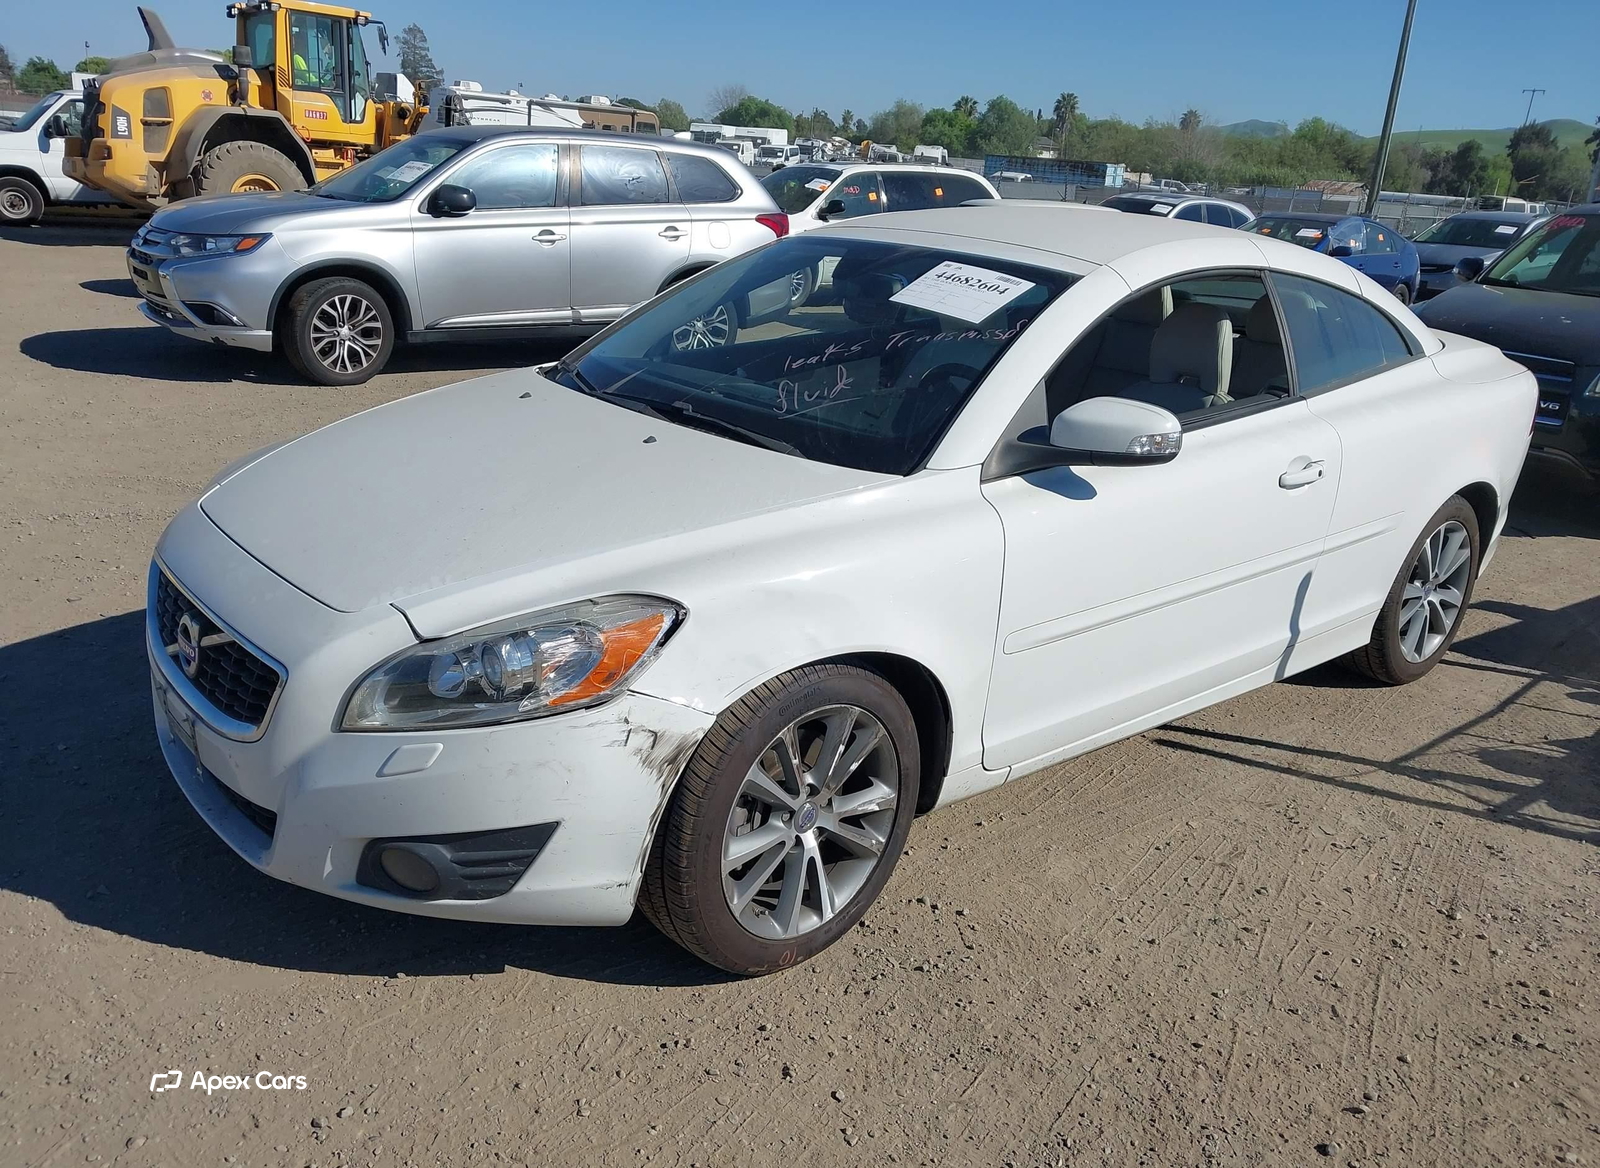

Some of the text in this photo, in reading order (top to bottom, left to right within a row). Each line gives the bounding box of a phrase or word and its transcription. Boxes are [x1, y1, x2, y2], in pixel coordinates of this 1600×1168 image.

[116, 116, 129, 135] L90H
[935, 271, 1010, 295] 44682604
[1540, 401, 1560, 410] V6
